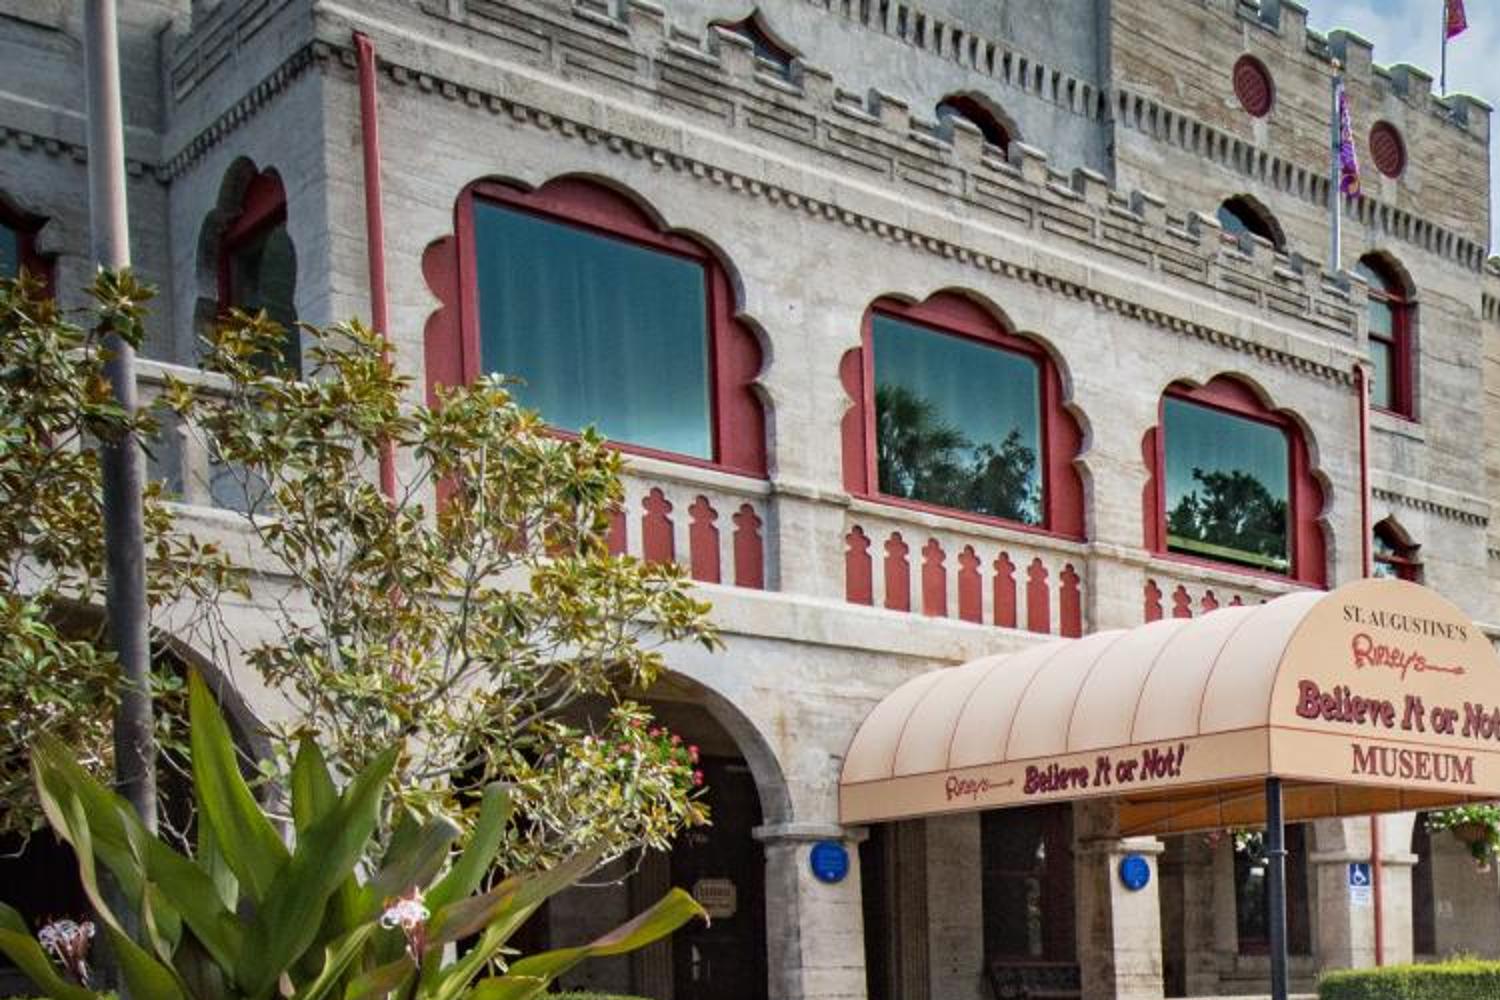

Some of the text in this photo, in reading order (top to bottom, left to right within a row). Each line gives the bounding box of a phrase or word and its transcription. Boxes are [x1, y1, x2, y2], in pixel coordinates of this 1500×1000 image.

[1343, 605, 1468, 641] ST. AUGUSTINE'S
[1296, 679, 1395, 729] Believe
[1401, 694, 1425, 732] It
[1430, 706, 1458, 734] or
[1023, 762, 1089, 794] Believe
[1093, 756, 1111, 787] It
[1116, 758, 1139, 783] or
[1140, 743, 1185, 781] Not!
[1351, 743, 1476, 784] MUSEUM
